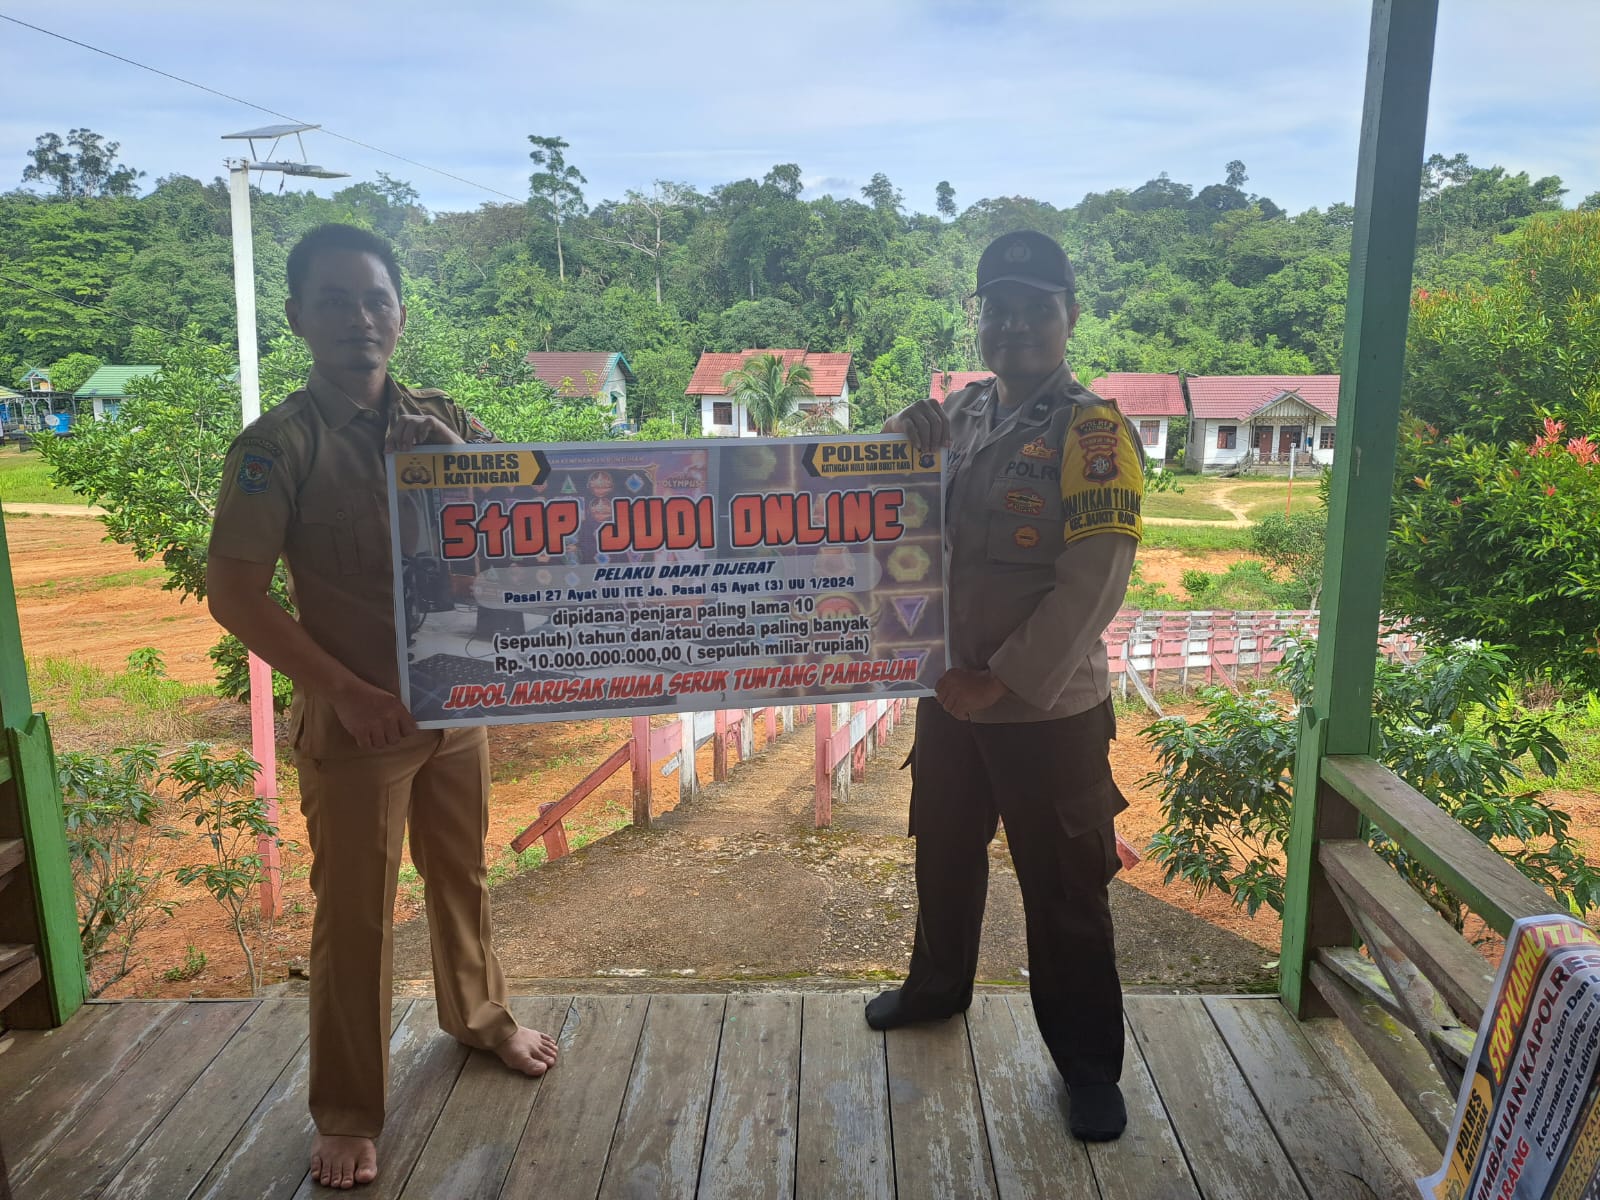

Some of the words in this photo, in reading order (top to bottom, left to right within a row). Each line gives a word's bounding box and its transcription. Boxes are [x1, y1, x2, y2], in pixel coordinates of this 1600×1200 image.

[443, 453, 520, 471] POLRES
[821, 463, 849, 473] KATINGAN
[822, 443, 908, 463] POLSEK
[444, 471, 520, 485] KATINGAN
[598, 496, 715, 552] JUDI
[730, 489, 905, 548] ONLINE
[504, 591, 541, 603] Pasal
[545, 590, 561, 601] 27
[567, 589, 597, 602] Ayat
[602, 588, 619, 598] UU
[625, 586, 643, 597] ITE
[648, 585, 667, 596] Jo.
[672, 583, 706, 596] Pasal
[711, 582, 727, 593] 45
[731, 581, 760, 594] Ayat
[765, 580, 783, 592] (3)
[789, 578, 805, 589] UU
[810, 577, 854, 588] 1/2024
[594, 566, 654, 581] PELAKU
[659, 563, 710, 578] DAPAT
[712, 561, 776, 576] DIJERAT
[494, 632, 572, 653] (sepuluh)
[578, 629, 625, 646] tahun
[630, 623, 701, 642] dan/atau
[706, 622, 754, 638] denda
[761, 620, 808, 637] paling
[813, 616, 869, 633] banyak
[552, 609, 625, 627] dipidana
[630, 604, 696, 624] penjara
[697, 603, 746, 622] paling
[751, 601, 789, 616] lama
[795, 598, 813, 612] 10
[495, 656, 523, 674] Rp.
[528, 646, 681, 670] 10.000.000.000,00
[697, 642, 760, 662] sepuluh
[765, 640, 810, 656] miliar
[815, 636, 869, 656] rupiah)
[443, 684, 507, 709] JUDOL
[509, 677, 605, 706] MARUSAK
[608, 674, 664, 700] HUMA
[668, 671, 729, 696] SERUK
[733, 664, 817, 690] TUNTANG
[820, 659, 918, 685] PAMBELUM
[1488, 1002, 1513, 1085] STOP
[1505, 924, 1600, 1026] KARHUTLA
[1524, 1053, 1555, 1130] Membakar
[1551, 1009, 1570, 1056] Hutan
[1566, 980, 1590, 1010] Dan
[1535, 1067, 1569, 1147] Kecamatan
[1564, 1001, 1595, 1068] Katingan
[1456, 1088, 1482, 1161] POLRES
[1464, 1103, 1489, 1174] KATINGAN
[1477, 1077, 1528, 1200] IMBAUAN
[1545, 1082, 1579, 1162] Kabupaten
